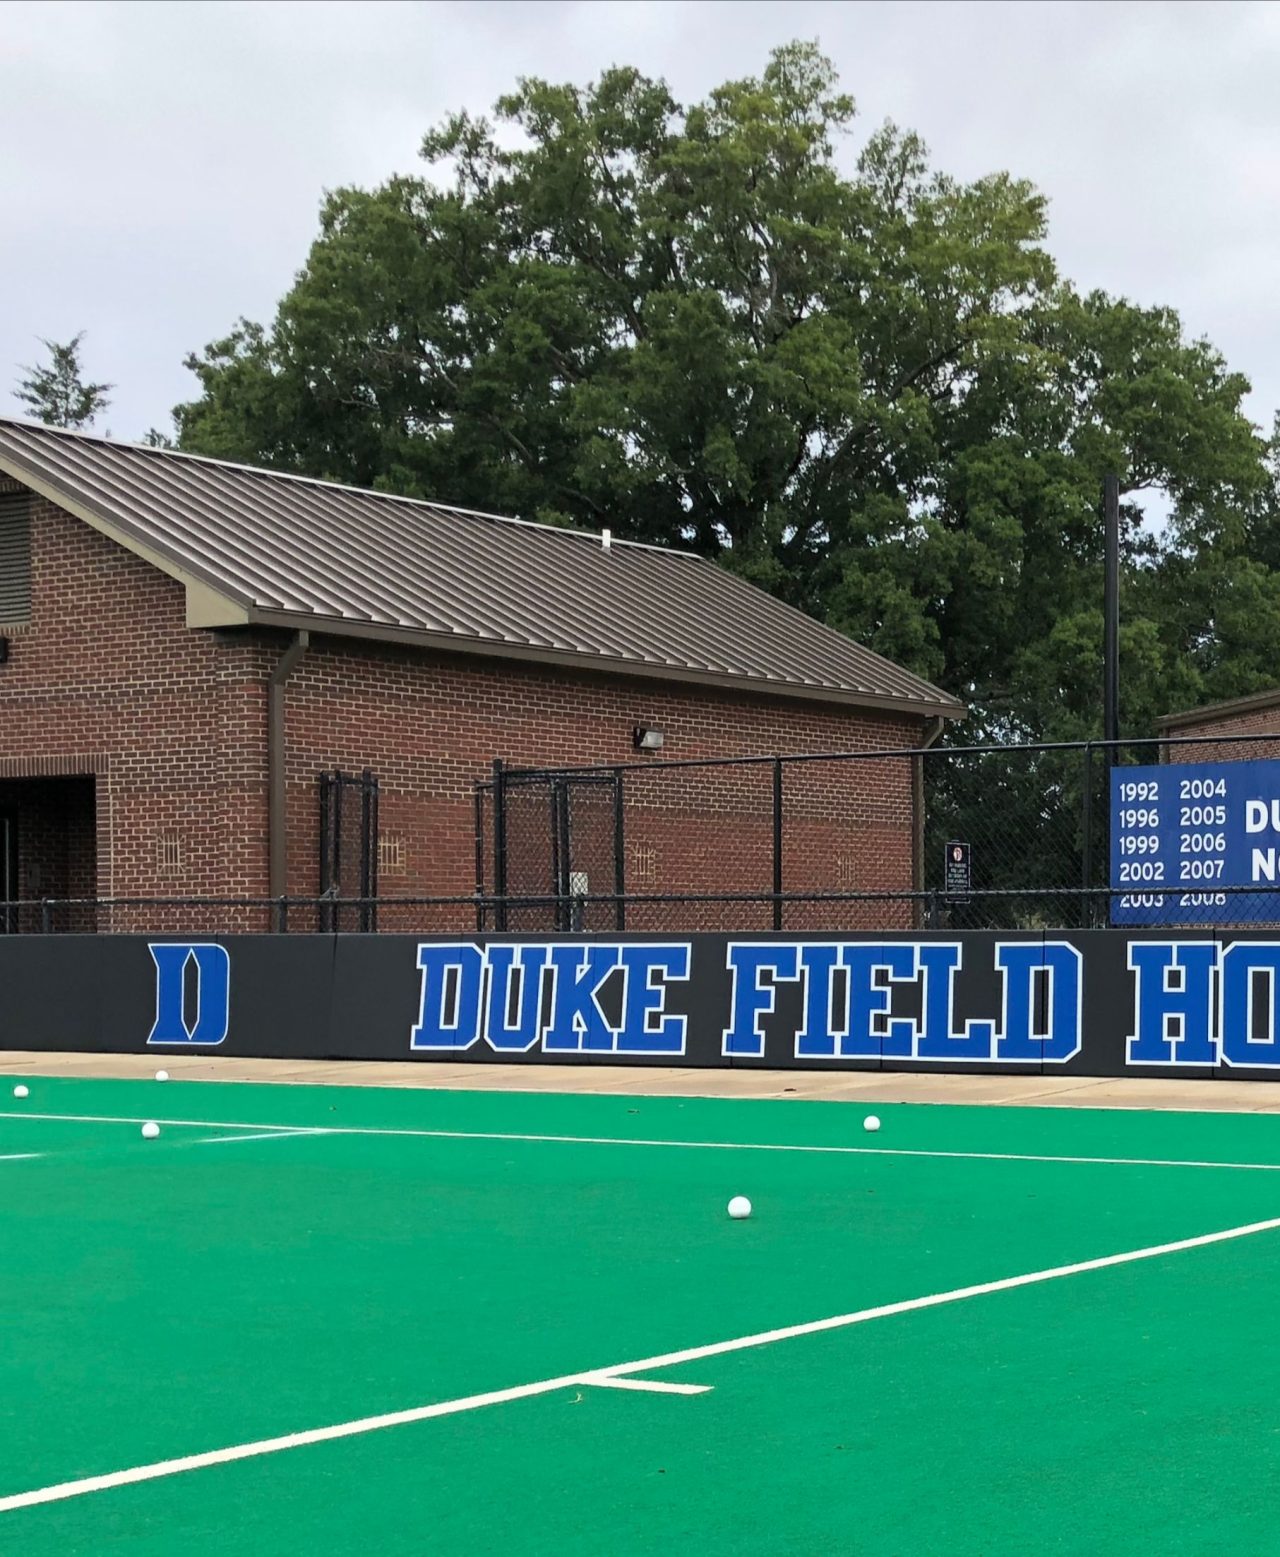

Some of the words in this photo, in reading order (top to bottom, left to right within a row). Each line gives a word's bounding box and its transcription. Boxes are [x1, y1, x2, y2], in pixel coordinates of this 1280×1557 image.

[1119, 781, 1159, 802] 1992
[1180, 778, 1227, 799] 2004
[1119, 808, 1159, 828] 1996
[1180, 805, 1226, 826] 2005
[1119, 835, 1159, 856] 1999
[1180, 832, 1226, 853] 2006
[1119, 861, 1164, 882] 2002
[1179, 859, 1225, 880] 2007
[411, 942, 692, 1056] DUKE
[721, 941, 1083, 1064] FIELD
